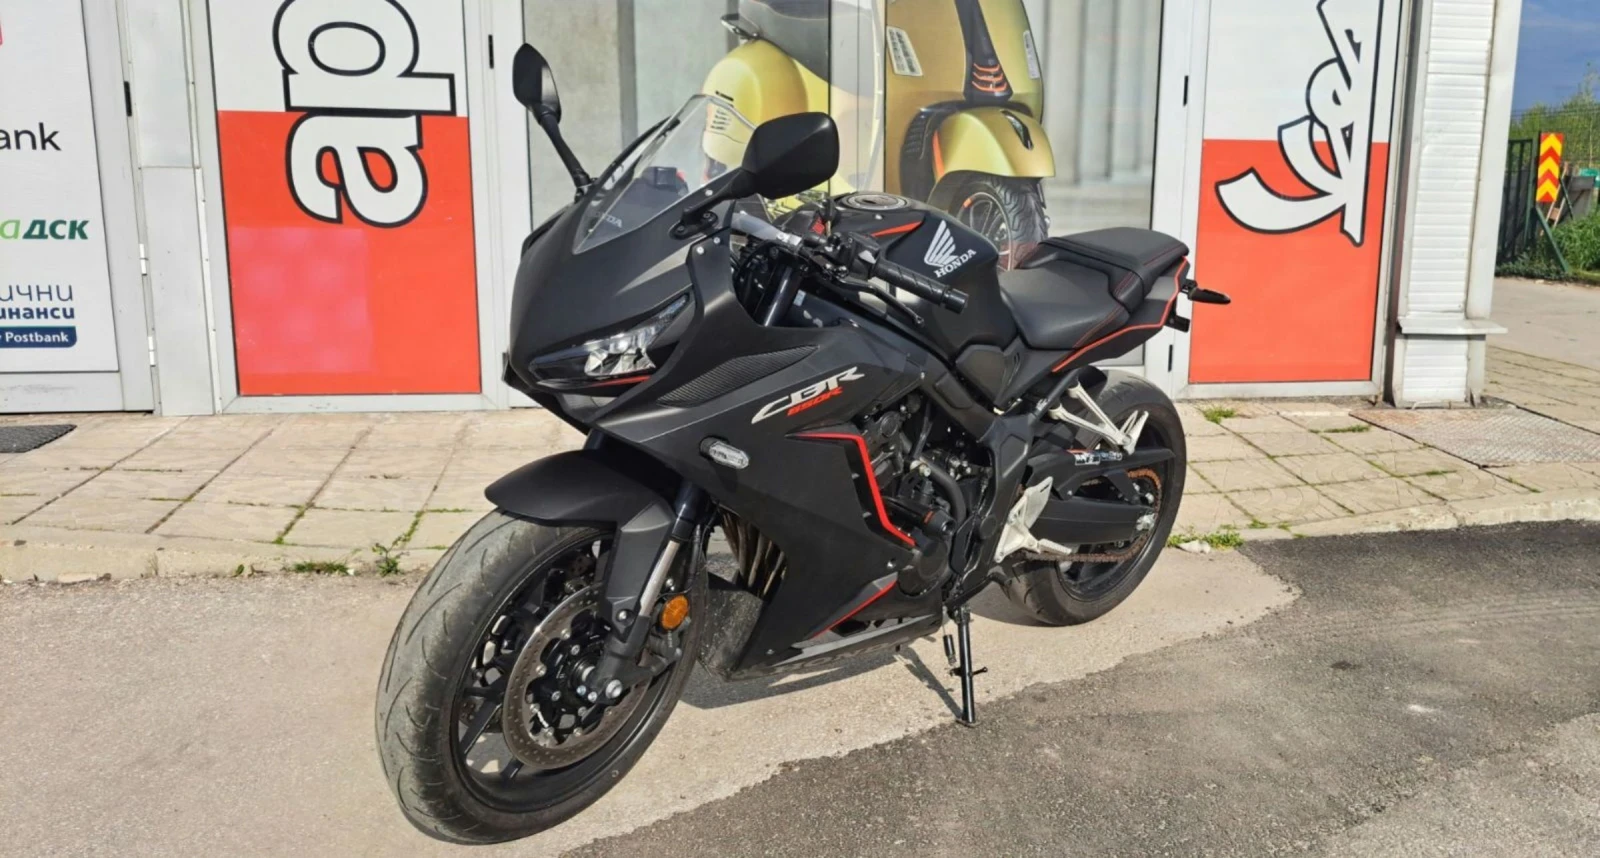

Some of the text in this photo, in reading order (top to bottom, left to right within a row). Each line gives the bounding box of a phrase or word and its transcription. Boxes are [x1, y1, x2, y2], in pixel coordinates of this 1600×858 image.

[933, 249, 977, 278] HONDA
[5, 331, 69, 343] Postbank
[751, 366, 865, 424] CBR
